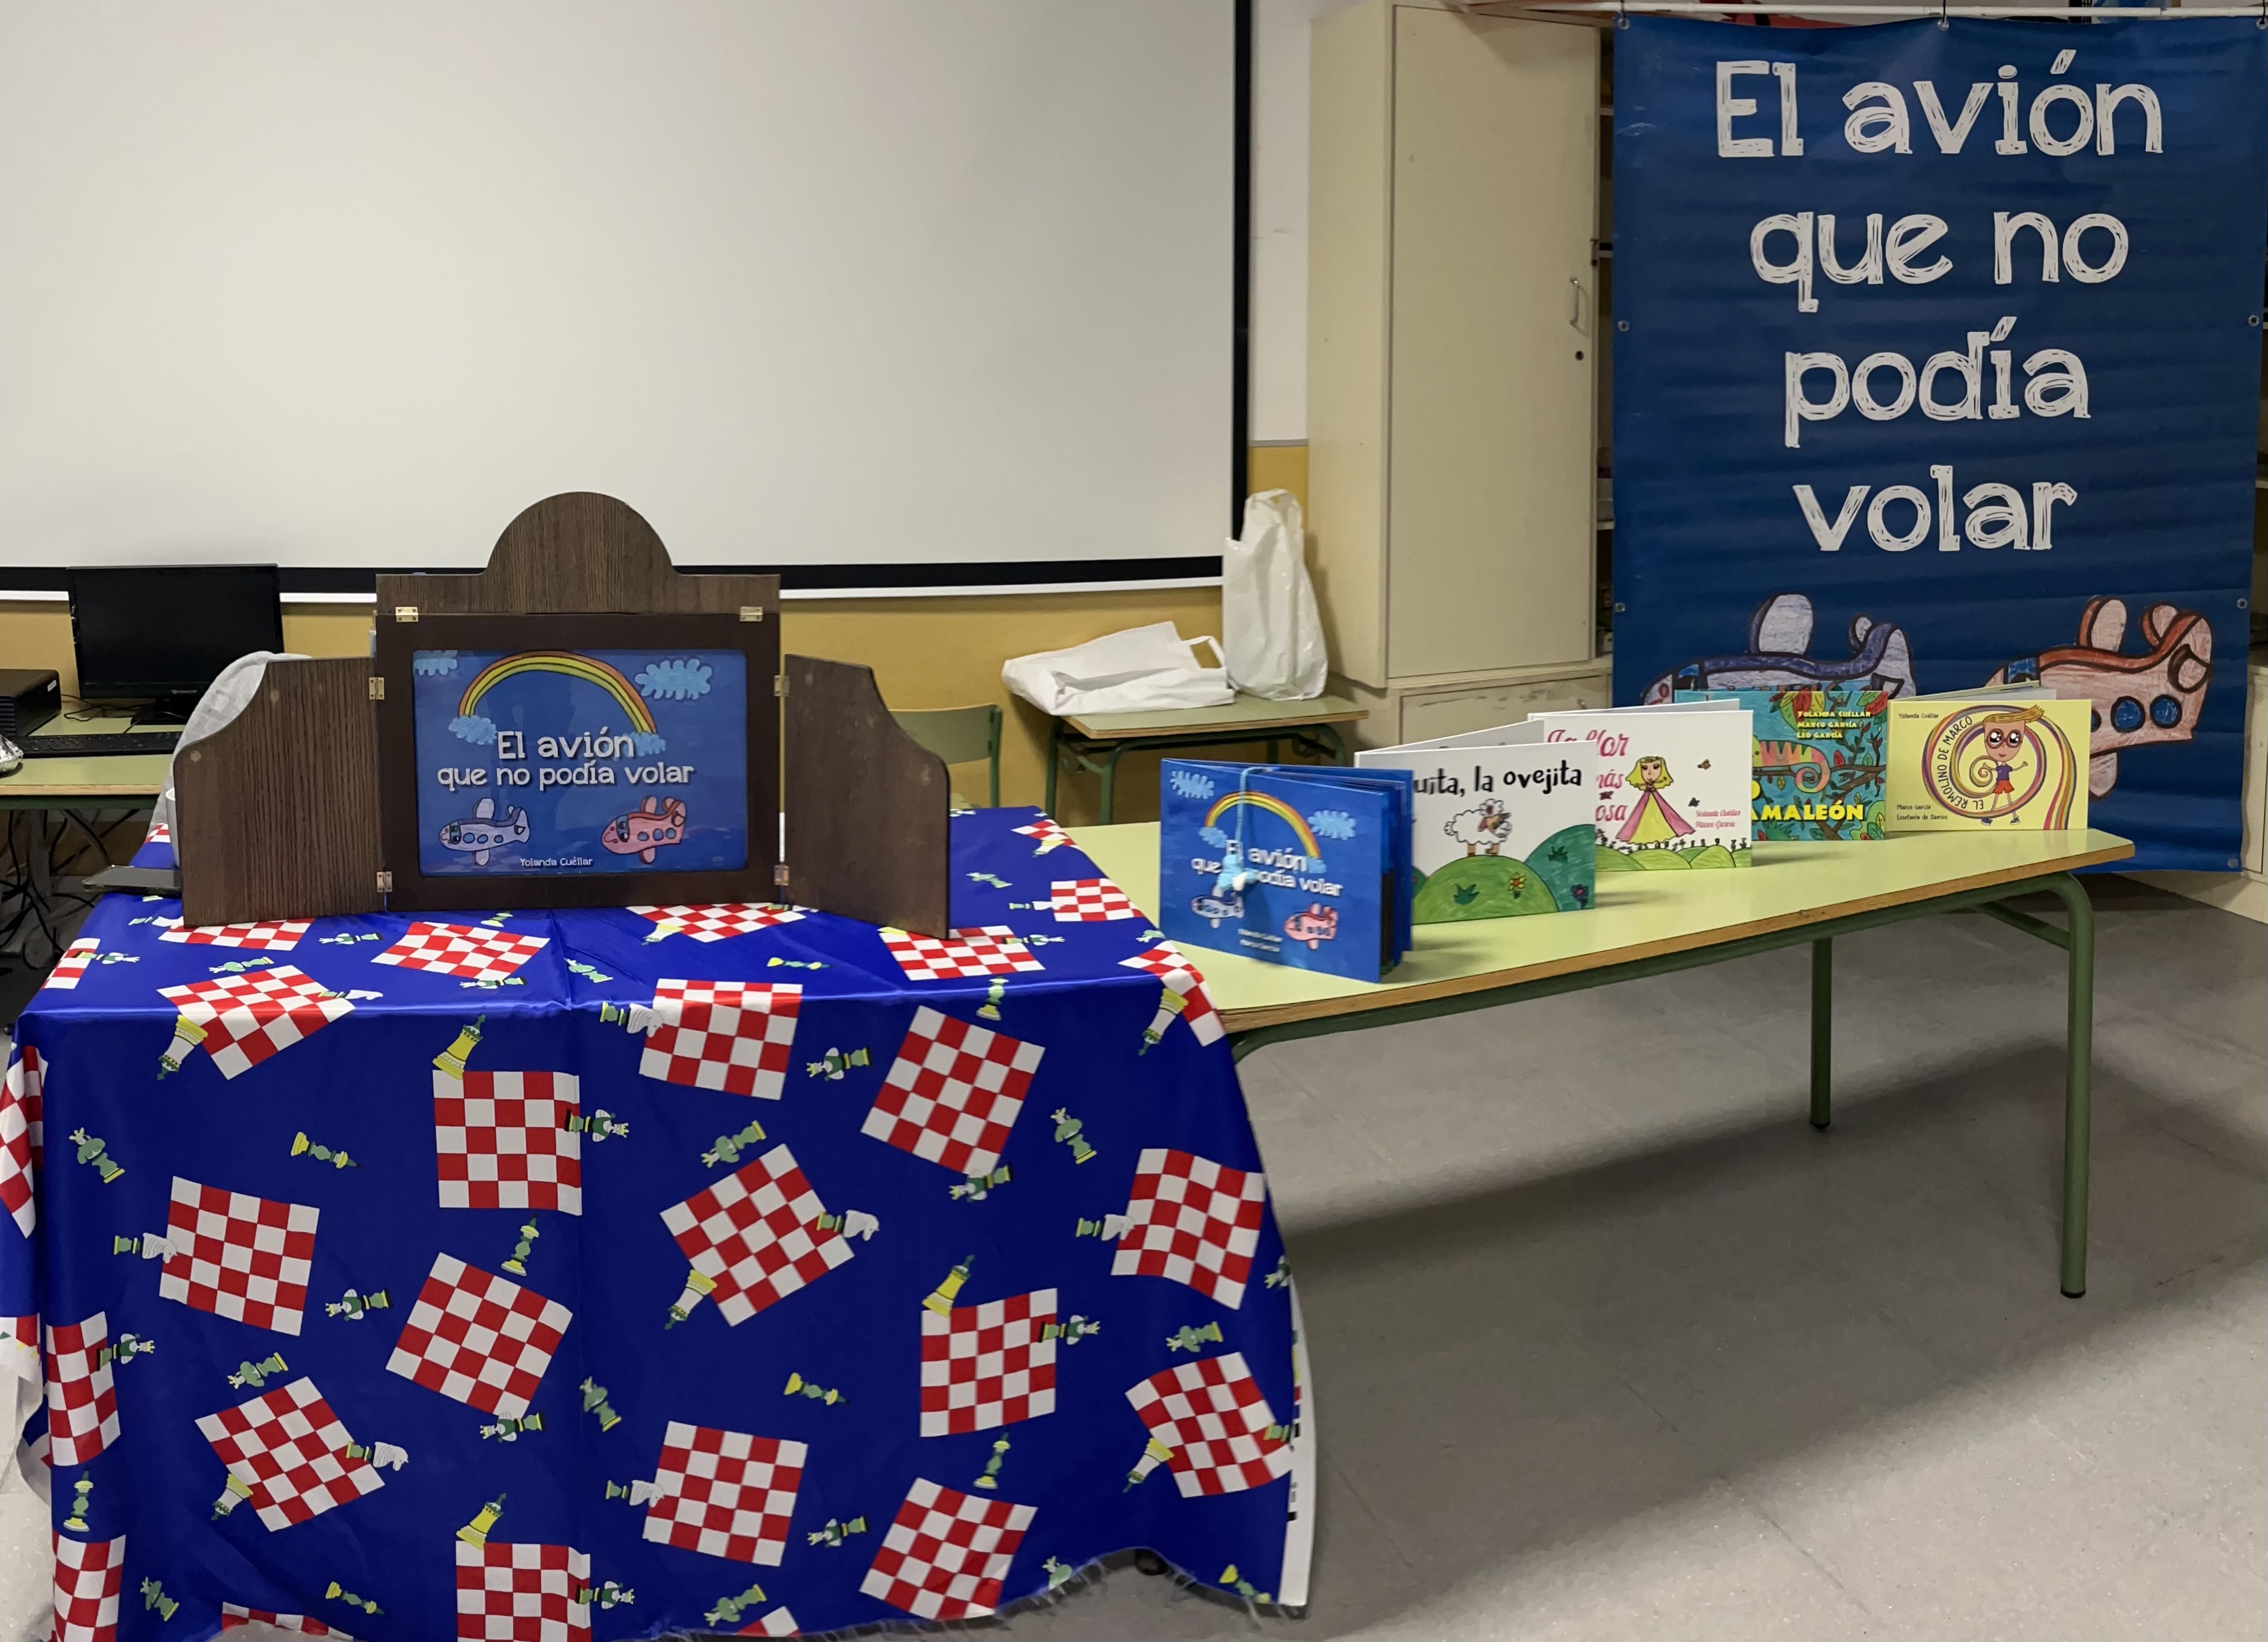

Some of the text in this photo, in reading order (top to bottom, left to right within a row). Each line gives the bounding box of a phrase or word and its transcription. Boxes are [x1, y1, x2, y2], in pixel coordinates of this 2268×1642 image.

[1716, 49, 2163, 158] El avión
[1750, 211, 2129, 312] que no
[1784, 316, 2091, 448] podía
[1792, 464, 2077, 551] volar
[497, 726, 634, 759] El avión
[438, 760, 695, 791] que no podía volar
[1474, 765, 1494, 793] la
[1503, 760, 1582, 794] ovejita
[1937, 716, 1984, 810] EL REMOLINO DE MARCO
[520, 856, 593, 866] Yolanda Cuéllar
[1191, 858, 1222, 875] que
[1248, 848, 1308, 872] avión
[1258, 869, 1344, 897] odía volar
